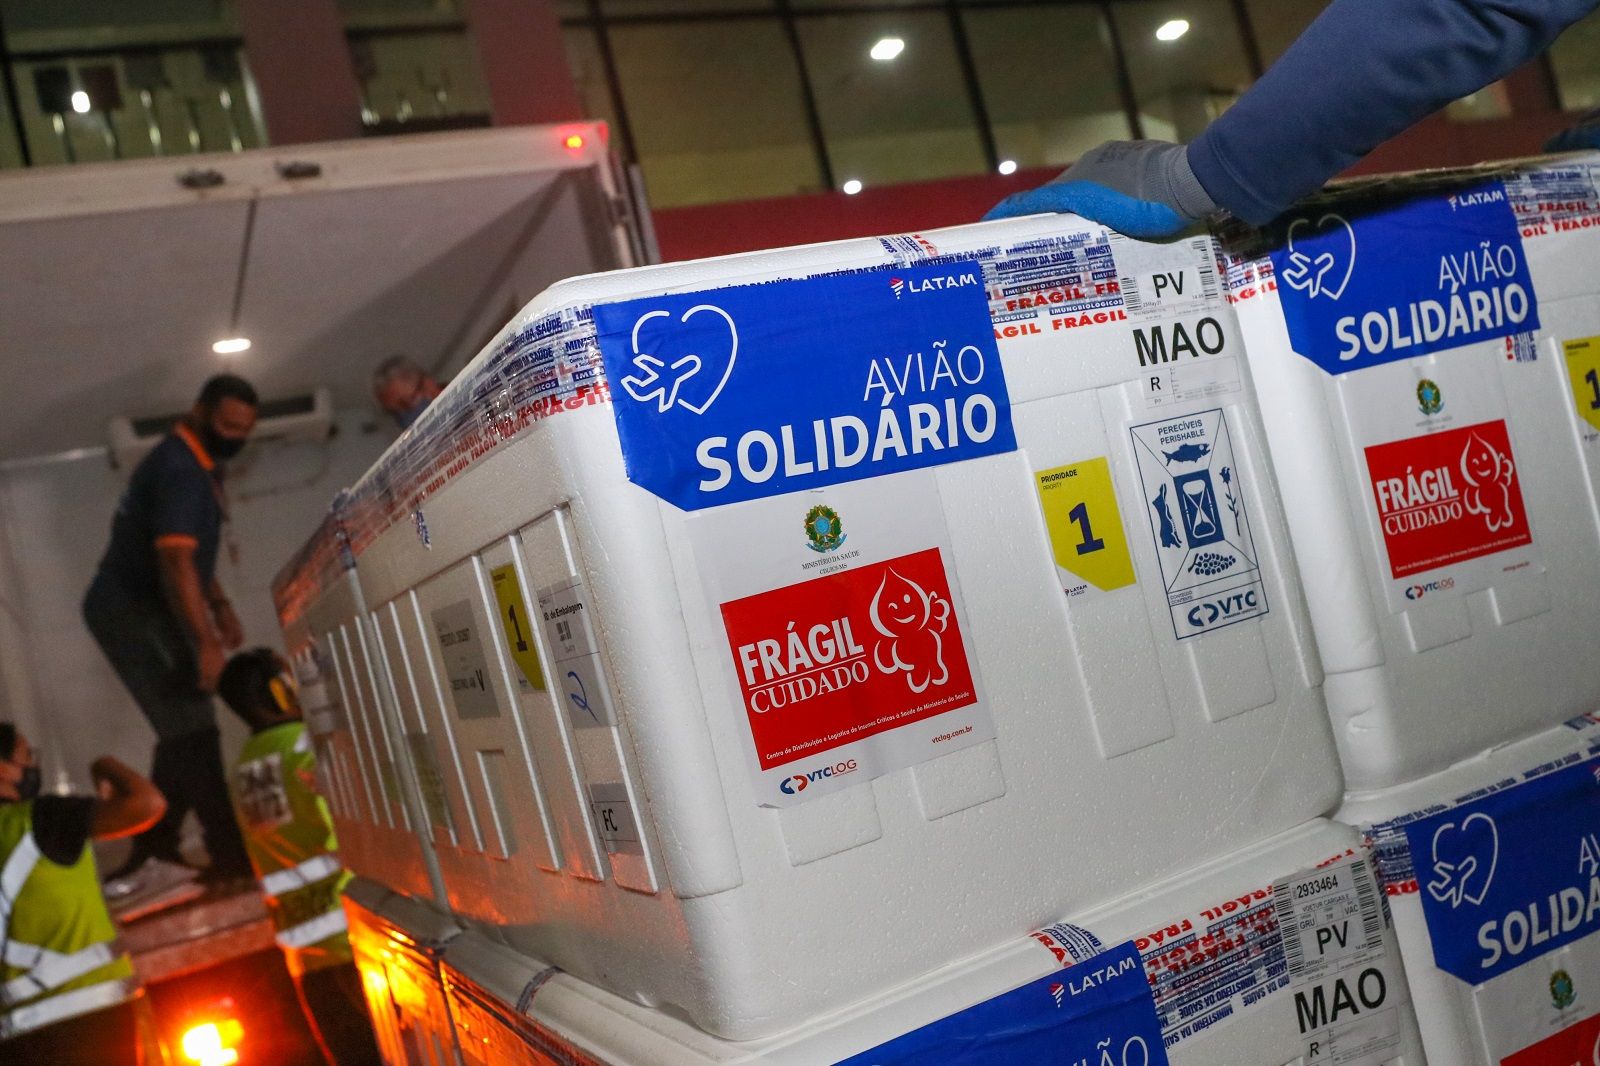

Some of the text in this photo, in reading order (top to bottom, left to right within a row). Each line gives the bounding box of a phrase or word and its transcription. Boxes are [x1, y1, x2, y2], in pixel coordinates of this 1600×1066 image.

[1459, 189, 1504, 208] LATAM
[995, 250, 1075, 272] MINISTÉRIO DA SAÚDE
[1438, 240, 1516, 291] AVIÃO
[909, 273, 978, 294] LATAM
[1152, 270, 1183, 298] PV
[1052, 309, 1127, 331] FRÁGIL
[1335, 282, 1529, 361] SOLIDÁRIO
[1132, 316, 1225, 367] MAO
[863, 340, 984, 402] AVIÃO
[1150, 376, 1161, 391] R
[1157, 419, 1203, 436] PERECÍVEIS
[1160, 429, 1205, 445] PERISHABLE
[695, 391, 997, 493] SOLIDÁRIO
[1041, 469, 1078, 484] PRIORIDADE
[1376, 465, 1458, 513] FRÁGIL
[1068, 502, 1105, 556] 1
[1384, 501, 1463, 535] CUIDADO
[841, 549, 860, 560] SAÚDE
[1070, 584, 1088, 593] LATAM
[1217, 590, 1257, 614] VTC
[509, 604, 528, 652] 1
[738, 617, 864, 685] FRÁGIL
[750, 661, 869, 714] CUIDADO
[931, 725, 973, 745] vtclog.com.br
[766, 750, 784, 760] Centro
[792, 738, 823, 752] Distribuição
[806, 759, 858, 783] VTCLOG
[602, 808, 618, 833] FC
[1296, 874, 1338, 899] 2933464
[1344, 904, 1359, 915] VAC
[1299, 918, 1316, 929] GRU
[1316, 920, 1348, 954] PV
[1068, 956, 1136, 997] LATAM
[1216, 975, 1257, 1002] MINISTÉRIO
[1268, 980, 1277, 994] DA
[1205, 992, 1216, 1005] DA
[1243, 987, 1267, 1007] SAÚDE
[1294, 967, 1387, 1035] MAO
[1179, 1000, 1204, 1020] SAÚDE
[1193, 1003, 1233, 1033] MINISTÉRIO
[1181, 1027, 1192, 1039] DA
[1309, 1041, 1320, 1058] R
